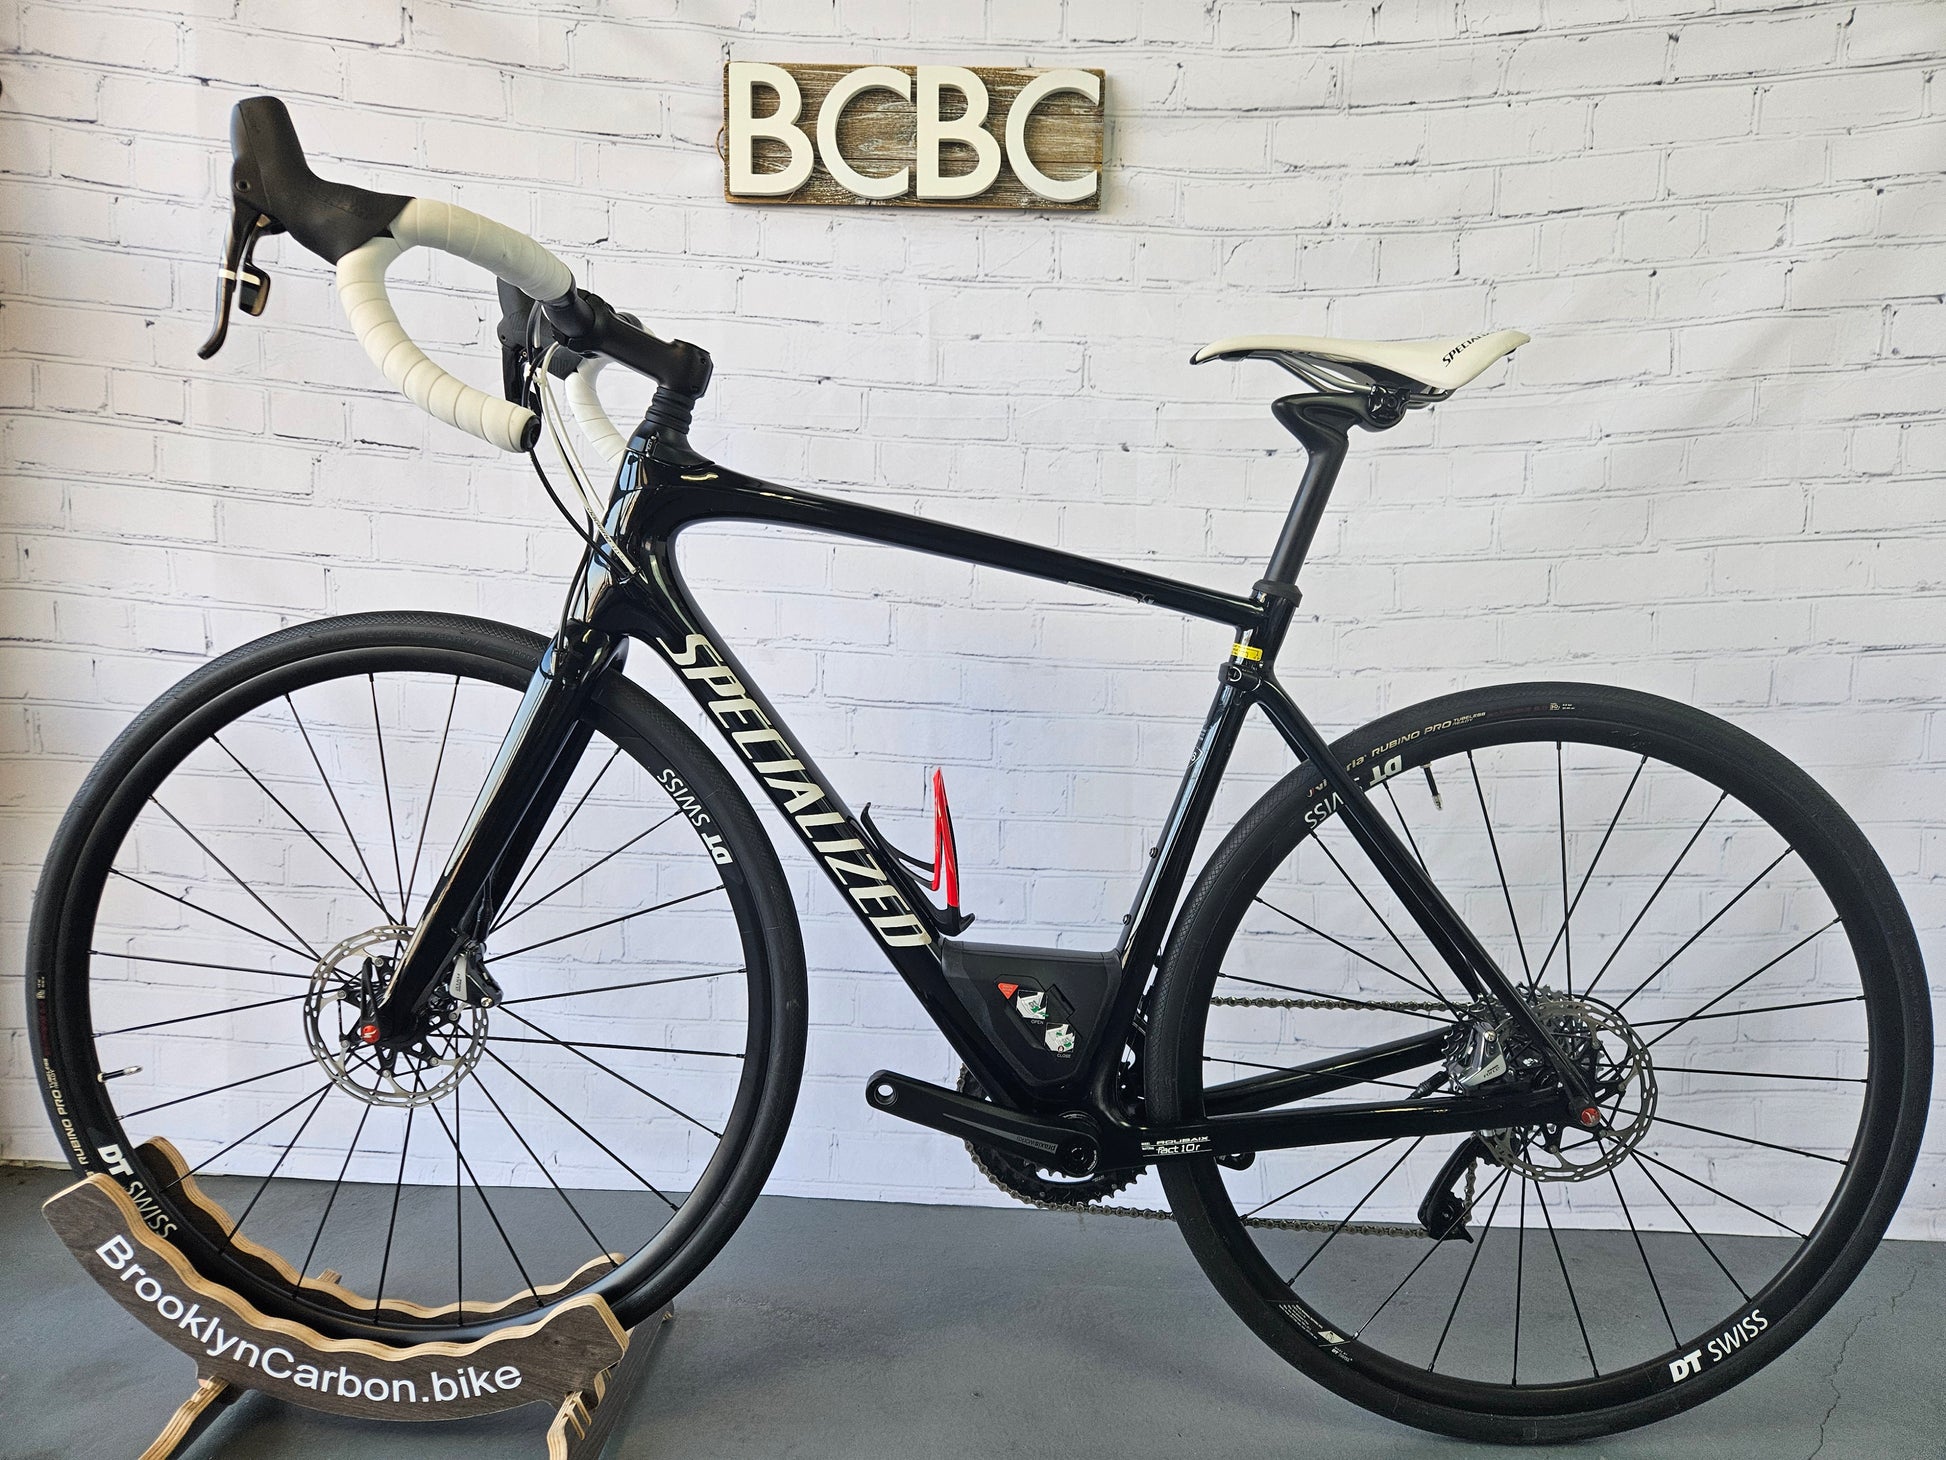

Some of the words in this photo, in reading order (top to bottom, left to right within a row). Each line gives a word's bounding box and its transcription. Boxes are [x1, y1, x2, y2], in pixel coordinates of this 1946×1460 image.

[729, 62, 1100, 202] BCBC
[1371, 731, 1421, 757] RUBINO
[1424, 720, 1452, 735] PRO
[656, 634, 932, 946] SPECIALIZED
[1370, 755, 1402, 786] DT
[656, 768, 711, 827] SWISS
[701, 833, 734, 865] DT
[51, 1089, 68, 1116] PRO
[61, 1118, 90, 1165] RUBINO
[1156, 1136, 1209, 1145] ROUBAIX
[1156, 1145, 1179, 1155] fact
[98, 1144, 134, 1176] DT
[127, 1181, 178, 1238] SWISS
[96, 1234, 522, 1404] BrooklynCarbon.bike
[1668, 1349, 1702, 1383] DT
[1707, 1309, 1768, 1362] SWISS
